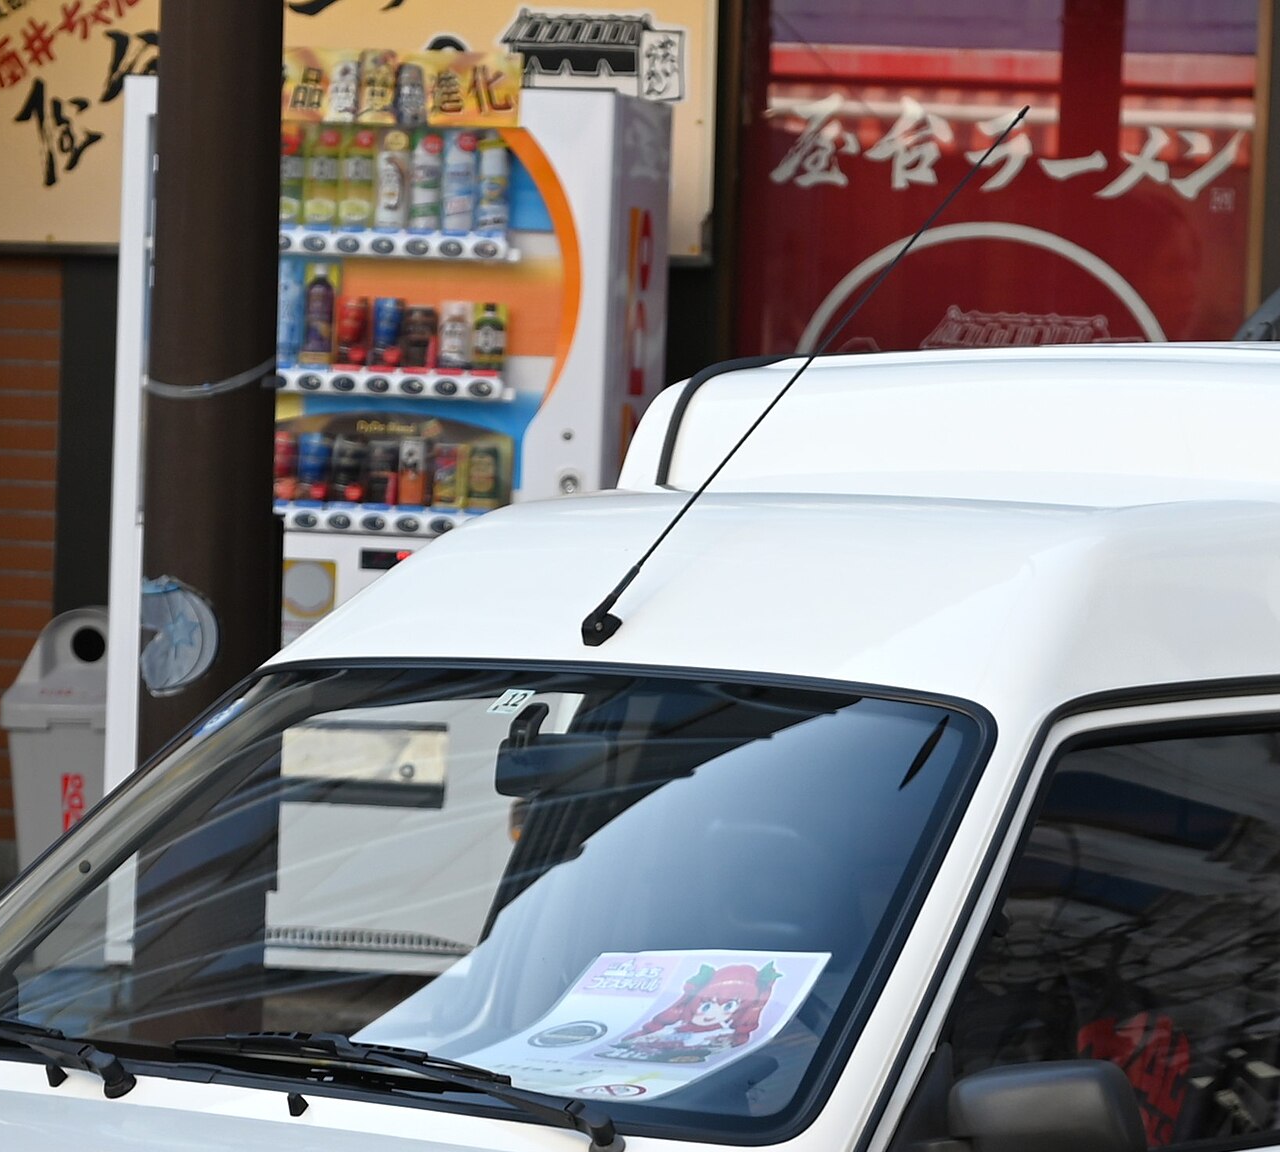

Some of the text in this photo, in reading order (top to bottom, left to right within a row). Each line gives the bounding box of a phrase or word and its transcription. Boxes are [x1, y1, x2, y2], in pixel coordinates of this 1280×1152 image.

[282, 66, 324, 109] 品
[431, 65, 514, 116] 進化
[770, 94, 1245, 199] 屋台ラーメン
[502, 691, 529, 707] 12
